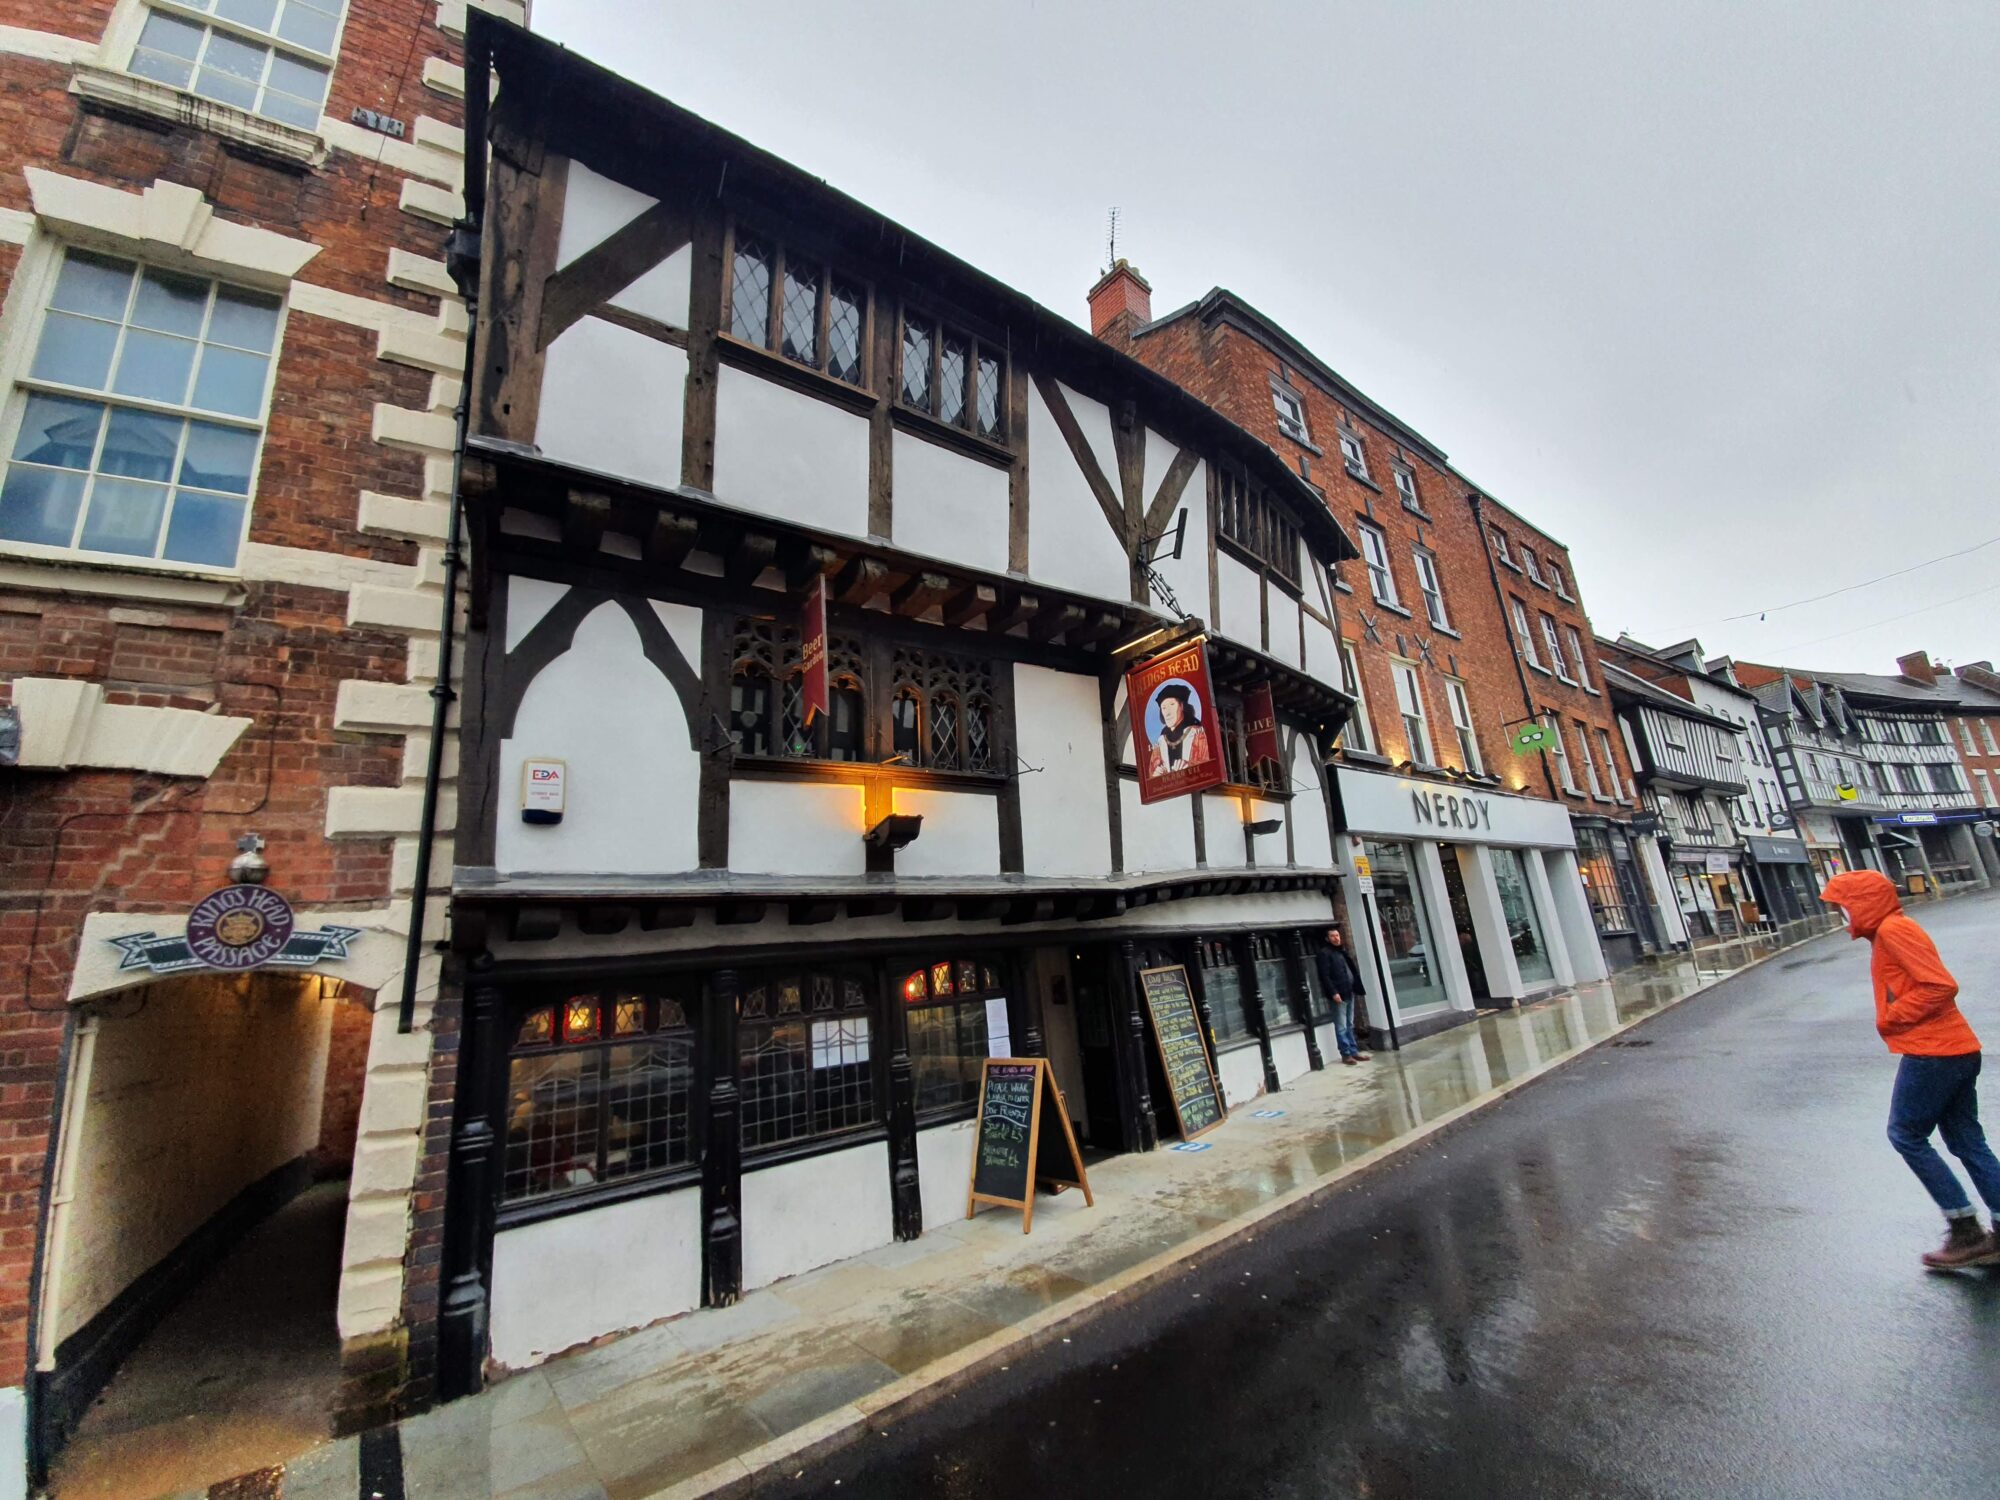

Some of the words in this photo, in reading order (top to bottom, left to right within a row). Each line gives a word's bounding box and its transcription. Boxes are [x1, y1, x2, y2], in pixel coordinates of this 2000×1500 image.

[802, 633, 823, 660] Beer
[1246, 716, 1274, 733] LIVE
[532, 769, 560, 781] EDA
[1411, 788, 1491, 831] NERDY
[248, 889, 290, 926] HEAD
[192, 933, 281, 966] PASSAGE
